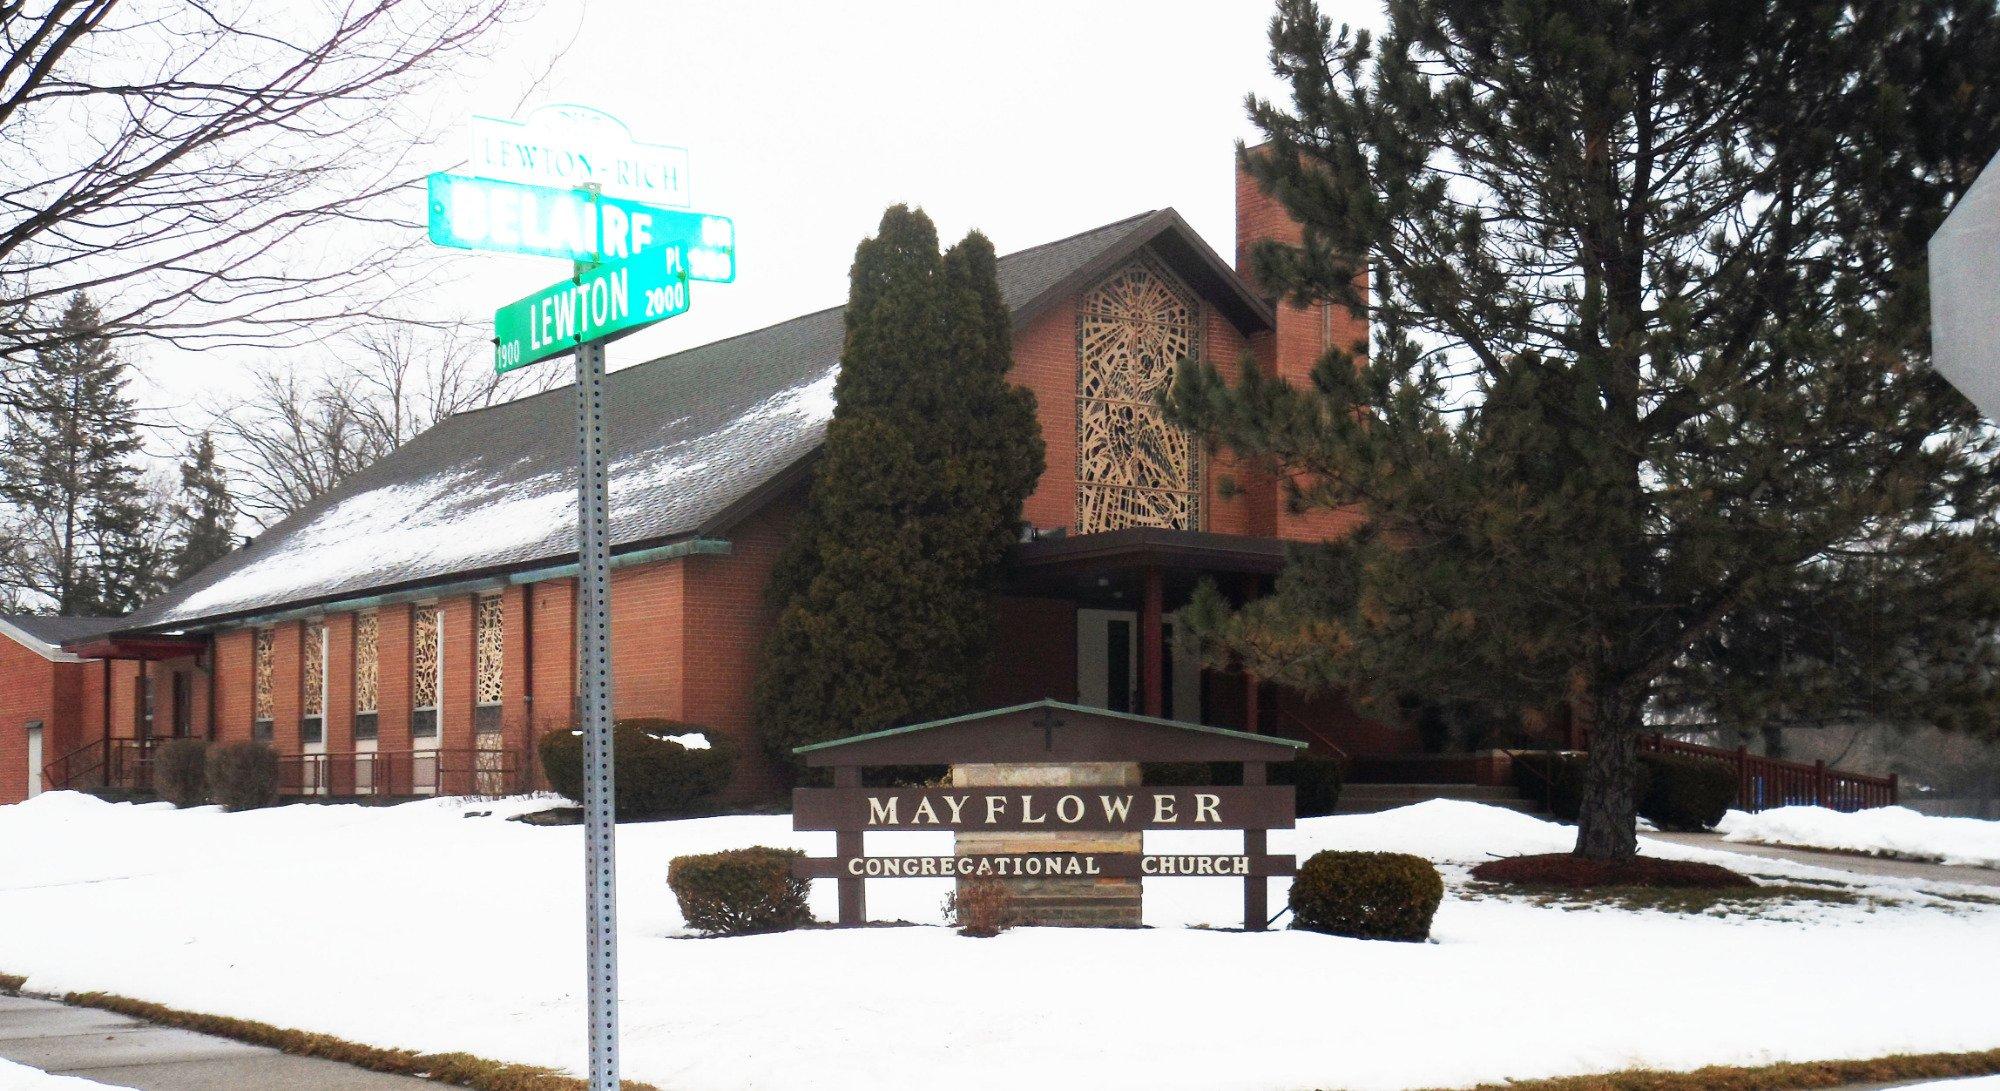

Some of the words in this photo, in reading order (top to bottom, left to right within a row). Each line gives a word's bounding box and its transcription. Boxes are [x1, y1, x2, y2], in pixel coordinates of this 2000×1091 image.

[531, 268, 629, 350] LEWTON
[666, 246, 683, 275] PL
[645, 282, 684, 317] 2000
[497, 339, 520, 370] 1900
[868, 793, 1223, 826] MAYFLOWER
[847, 856, 1100, 876] CONGREGATIONAL
[1141, 856, 1251, 876] CHURCH
